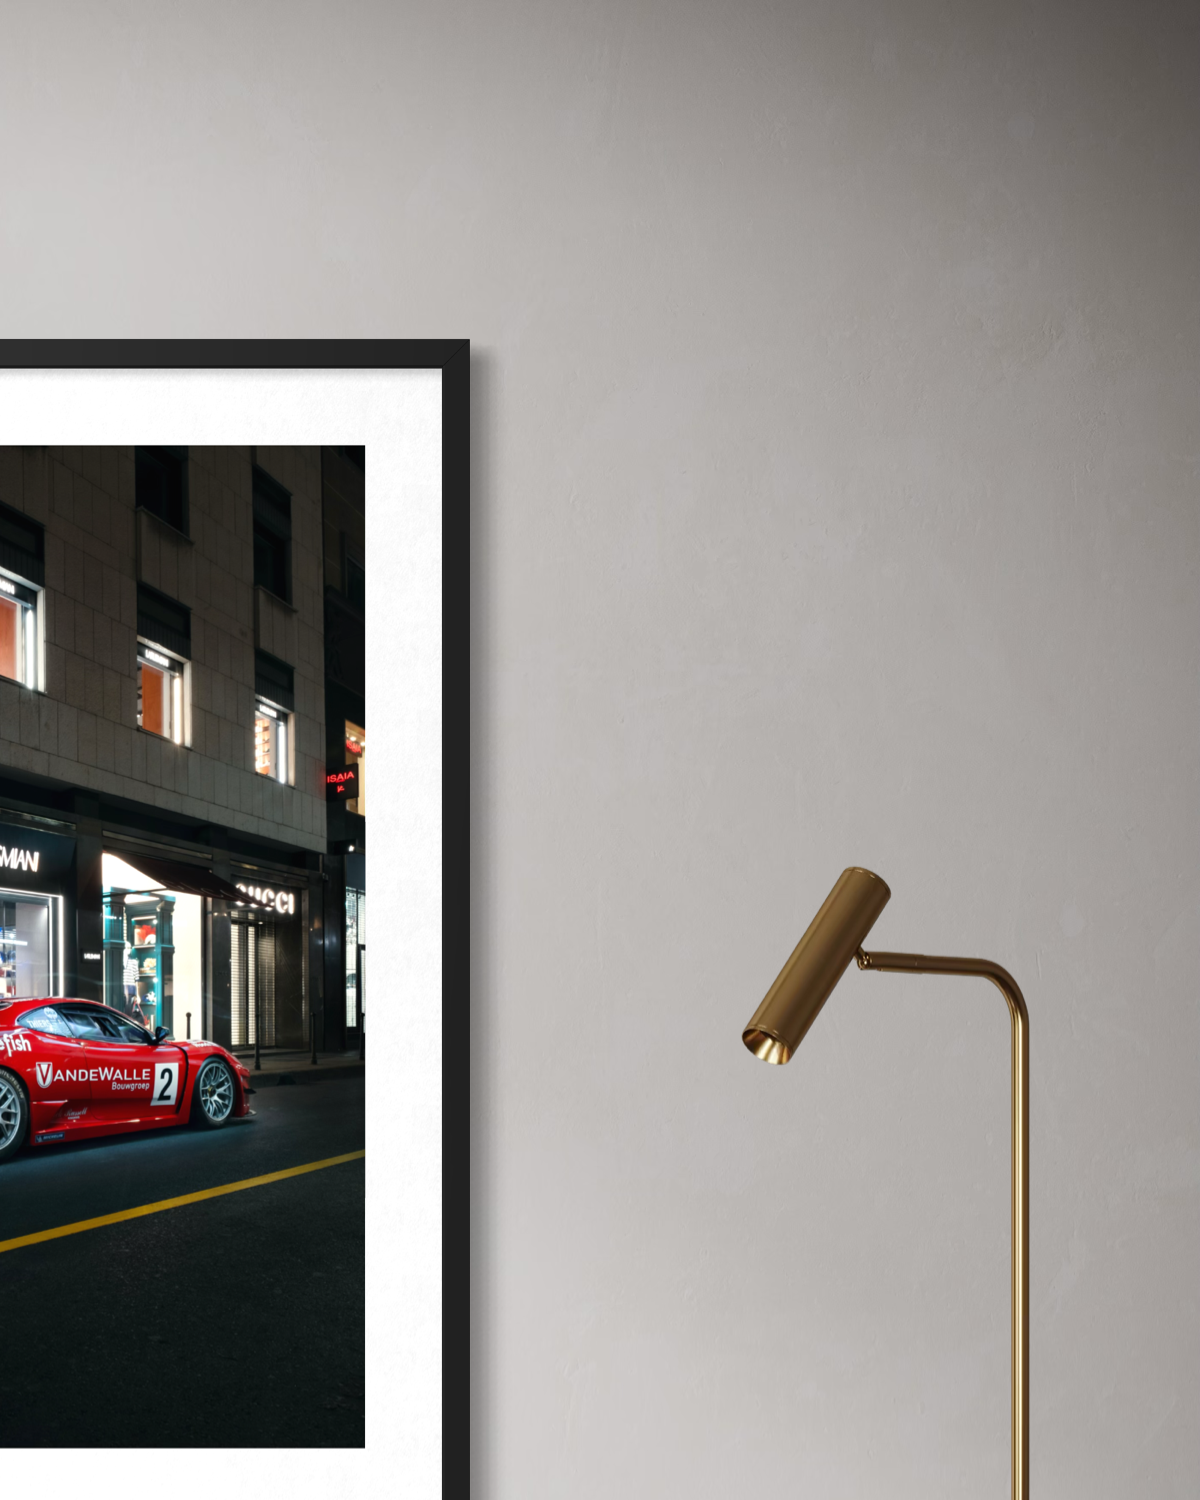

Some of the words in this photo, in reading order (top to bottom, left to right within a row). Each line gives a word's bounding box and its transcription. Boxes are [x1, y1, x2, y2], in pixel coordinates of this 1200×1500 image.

[327, 771, 355, 783] ISAIA
[111, 1081, 150, 1091] Bouwgroep
[157, 1067, 174, 1102] 2
